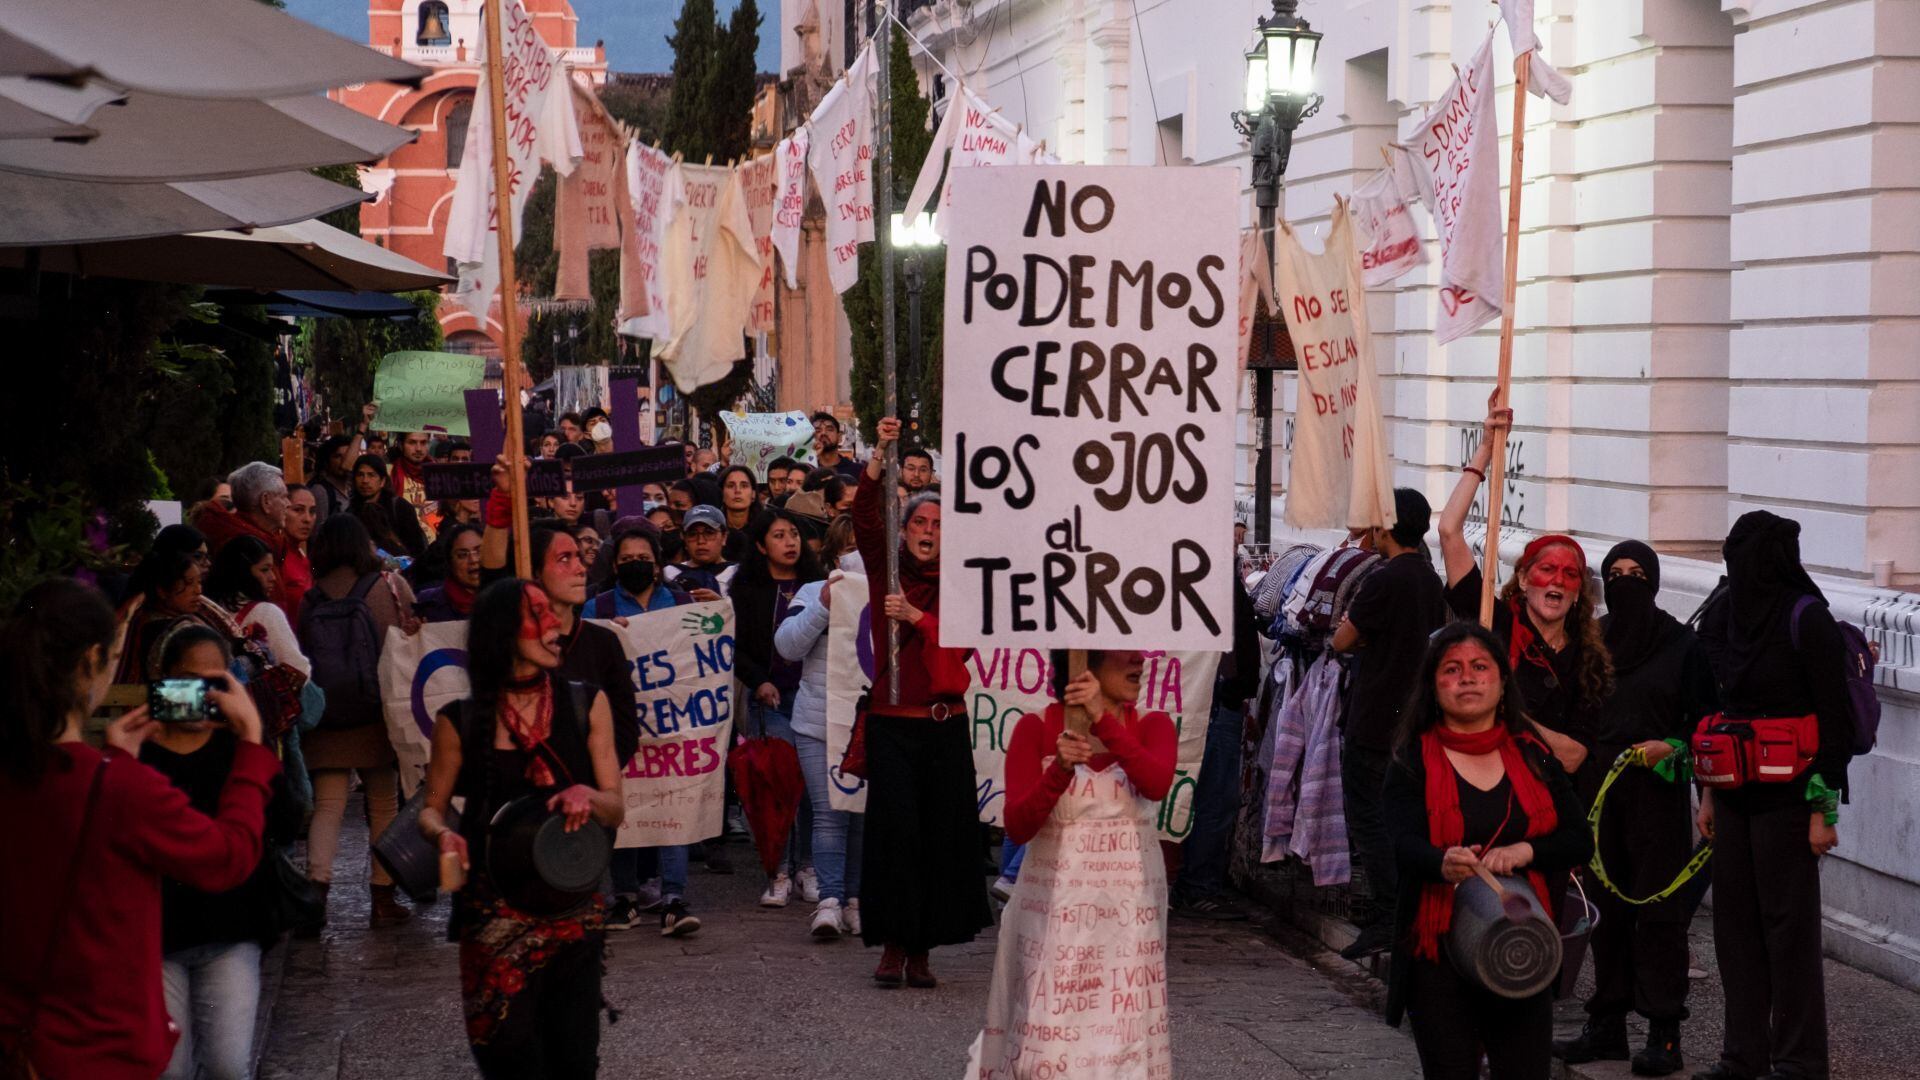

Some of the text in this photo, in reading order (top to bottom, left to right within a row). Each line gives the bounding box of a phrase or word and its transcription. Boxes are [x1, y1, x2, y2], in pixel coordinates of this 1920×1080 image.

[505, 3, 552, 91] SCRIBO
[962, 134, 1008, 155] LLAMAN
[1023, 179, 1115, 237] NO
[963, 245, 1225, 331] PODEMOS
[1294, 294, 1322, 324] NO
[991, 340, 1221, 422] CERRAR
[1312, 391, 1338, 416] DE
[954, 423, 1208, 514] LOS OJOS
[963, 538, 1222, 636] TERROR
[694, 634, 735, 678] NO
[1053, 962, 1104, 979] BRENDA
[1055, 944, 1106, 962] SOBRE
[1052, 993, 1100, 1016] JADE
[1014, 1022, 1080, 1042] NOMBRES
